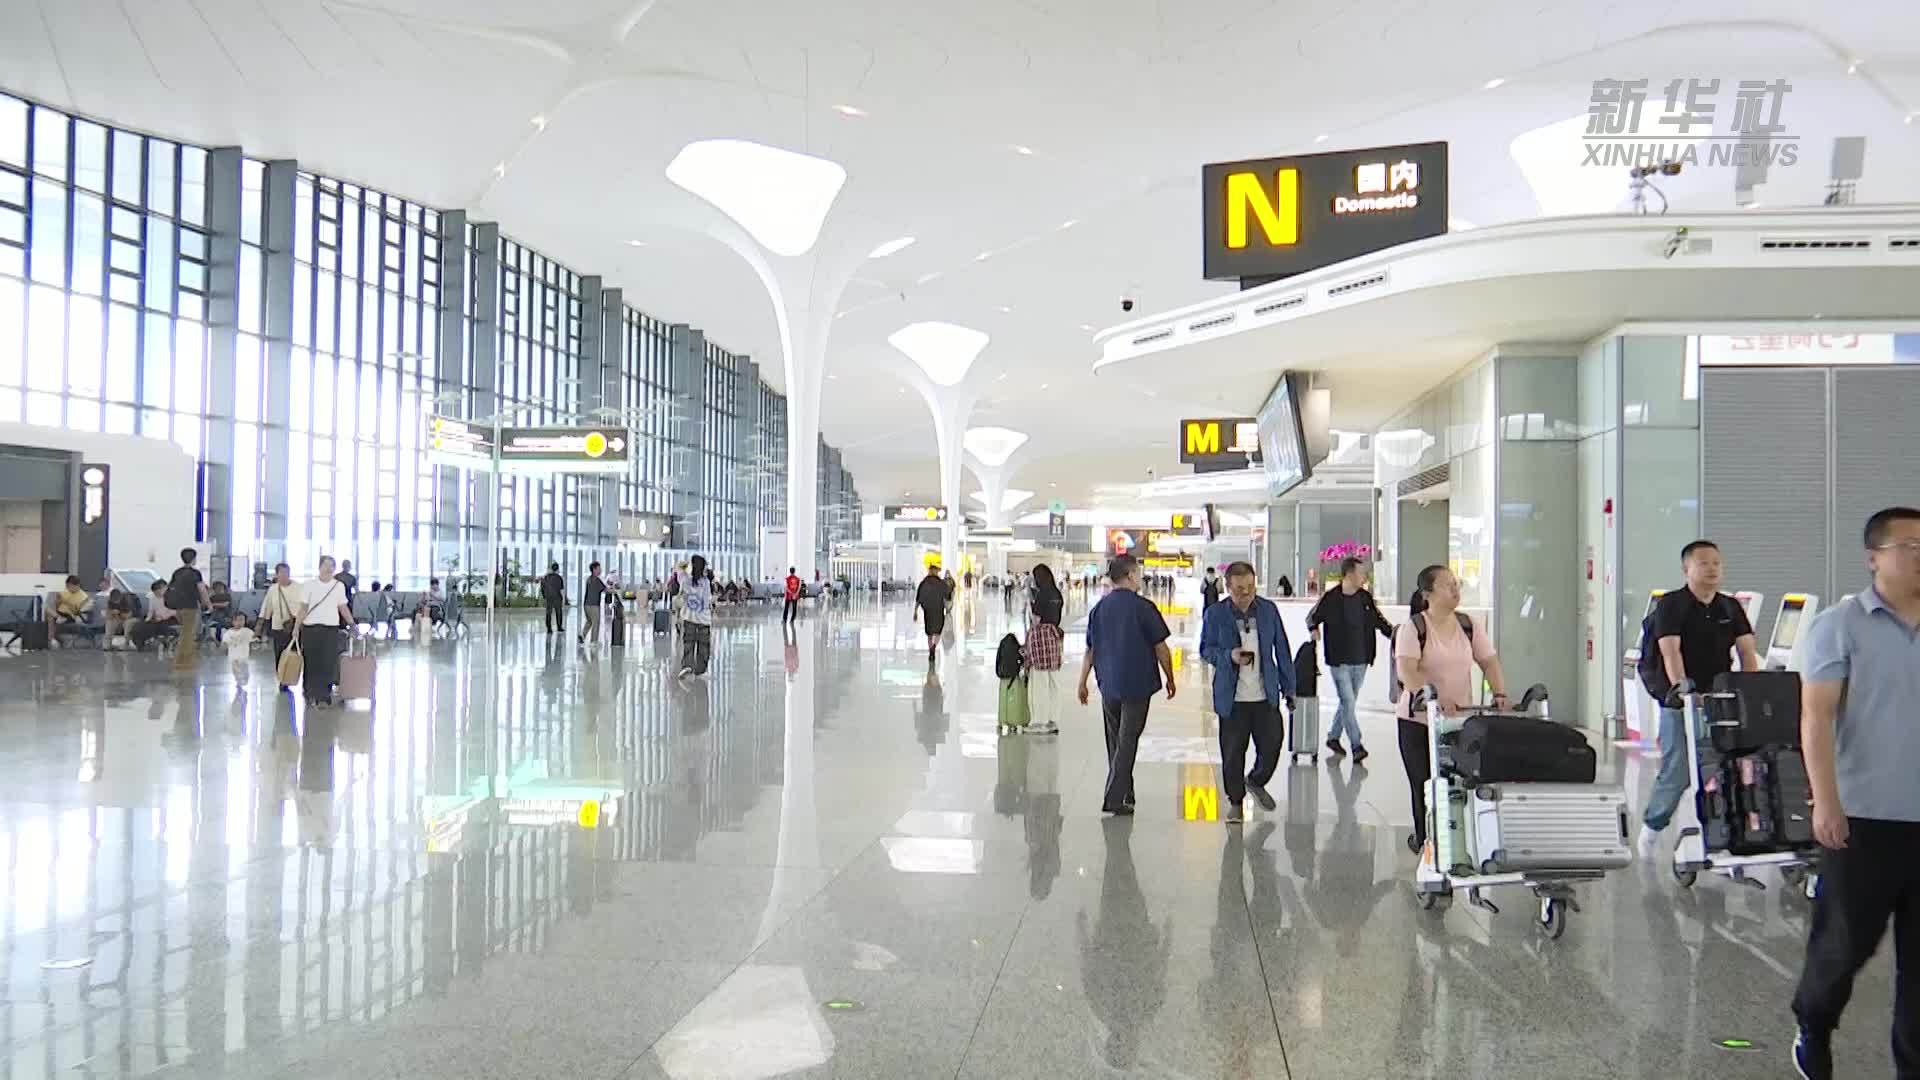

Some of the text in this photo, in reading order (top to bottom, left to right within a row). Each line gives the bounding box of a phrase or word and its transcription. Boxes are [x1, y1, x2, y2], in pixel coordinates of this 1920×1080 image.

[1227, 168, 1297, 248] N
[1334, 192, 1418, 213] Domestic
[1186, 422, 1219, 454] M
